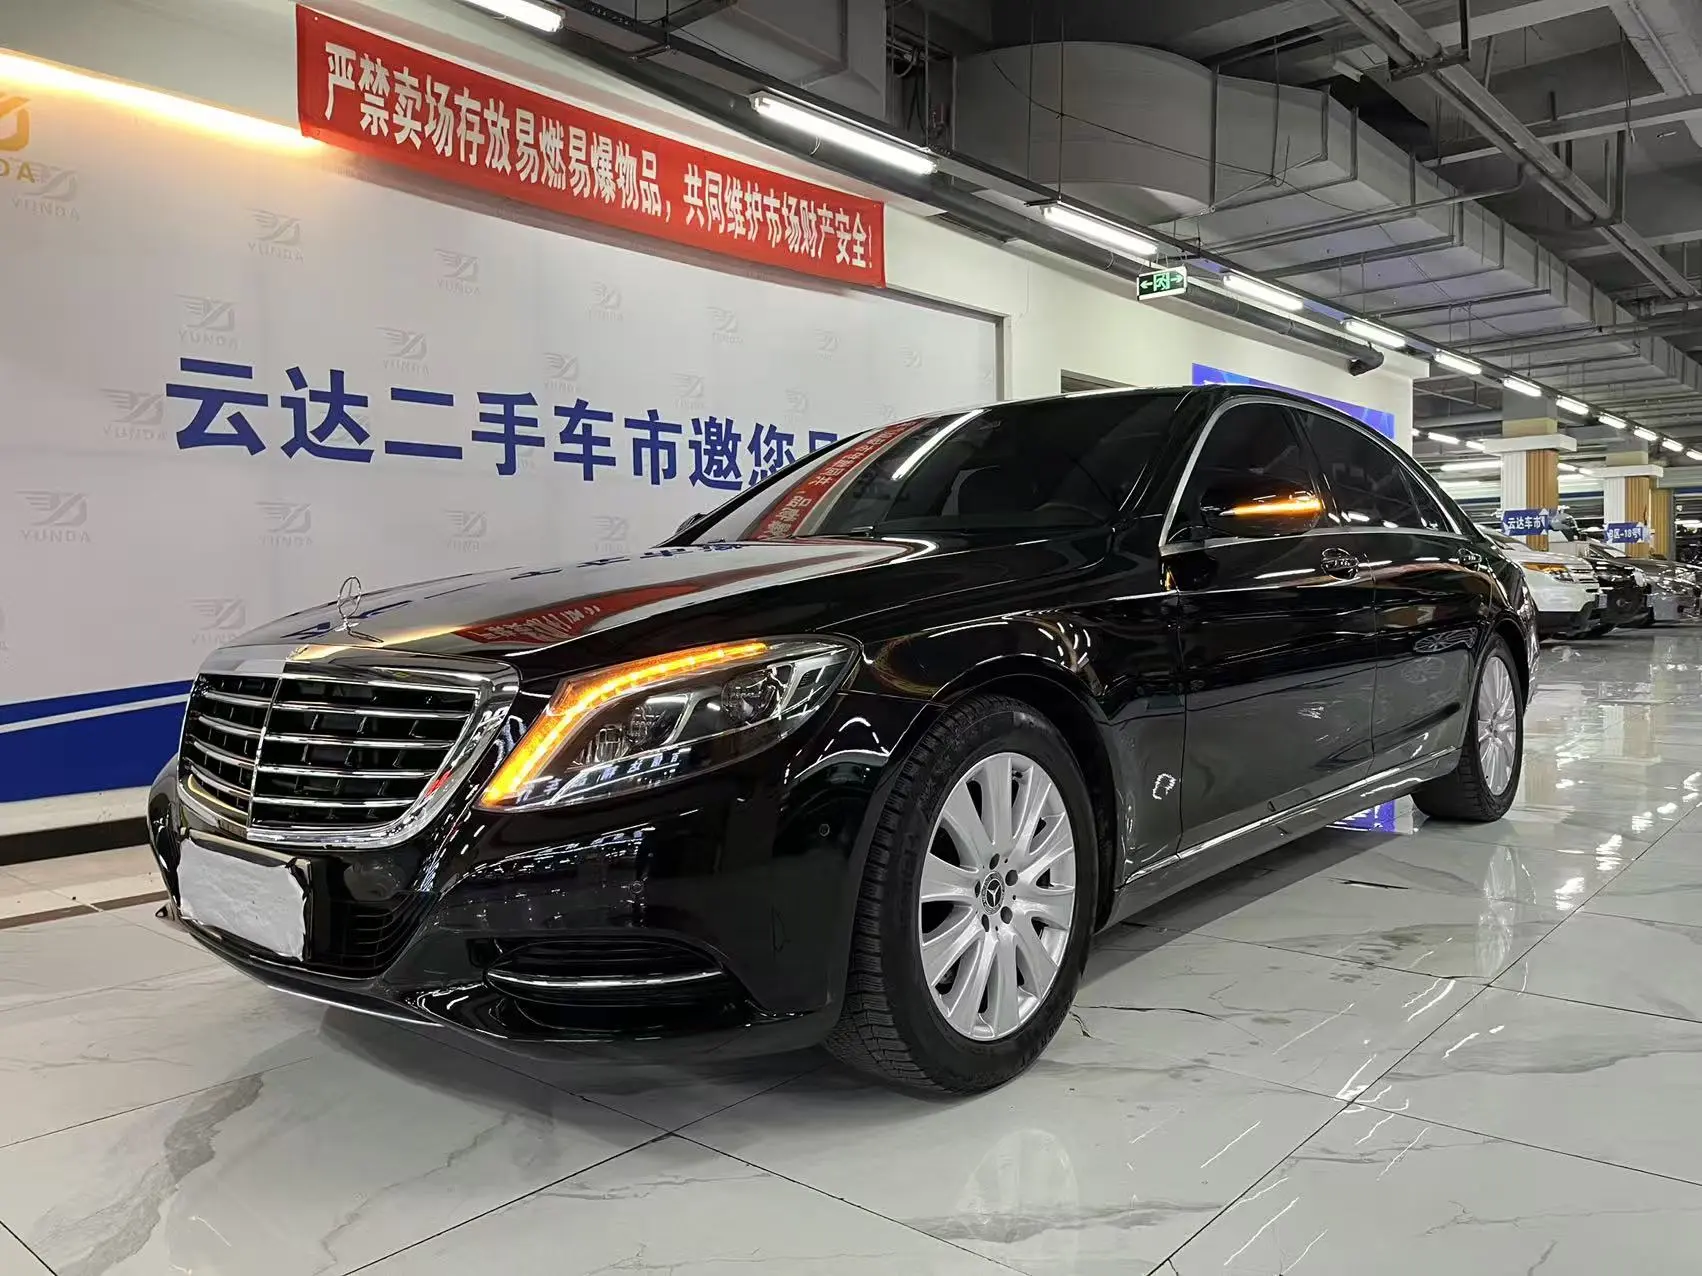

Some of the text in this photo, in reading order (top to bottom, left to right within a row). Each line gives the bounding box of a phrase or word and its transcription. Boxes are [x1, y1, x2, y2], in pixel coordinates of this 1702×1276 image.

[178, 329, 240, 350] YUNDA
[1508, 515, 1541, 530] 云达车市
[19, 529, 92, 543] YUNDA
